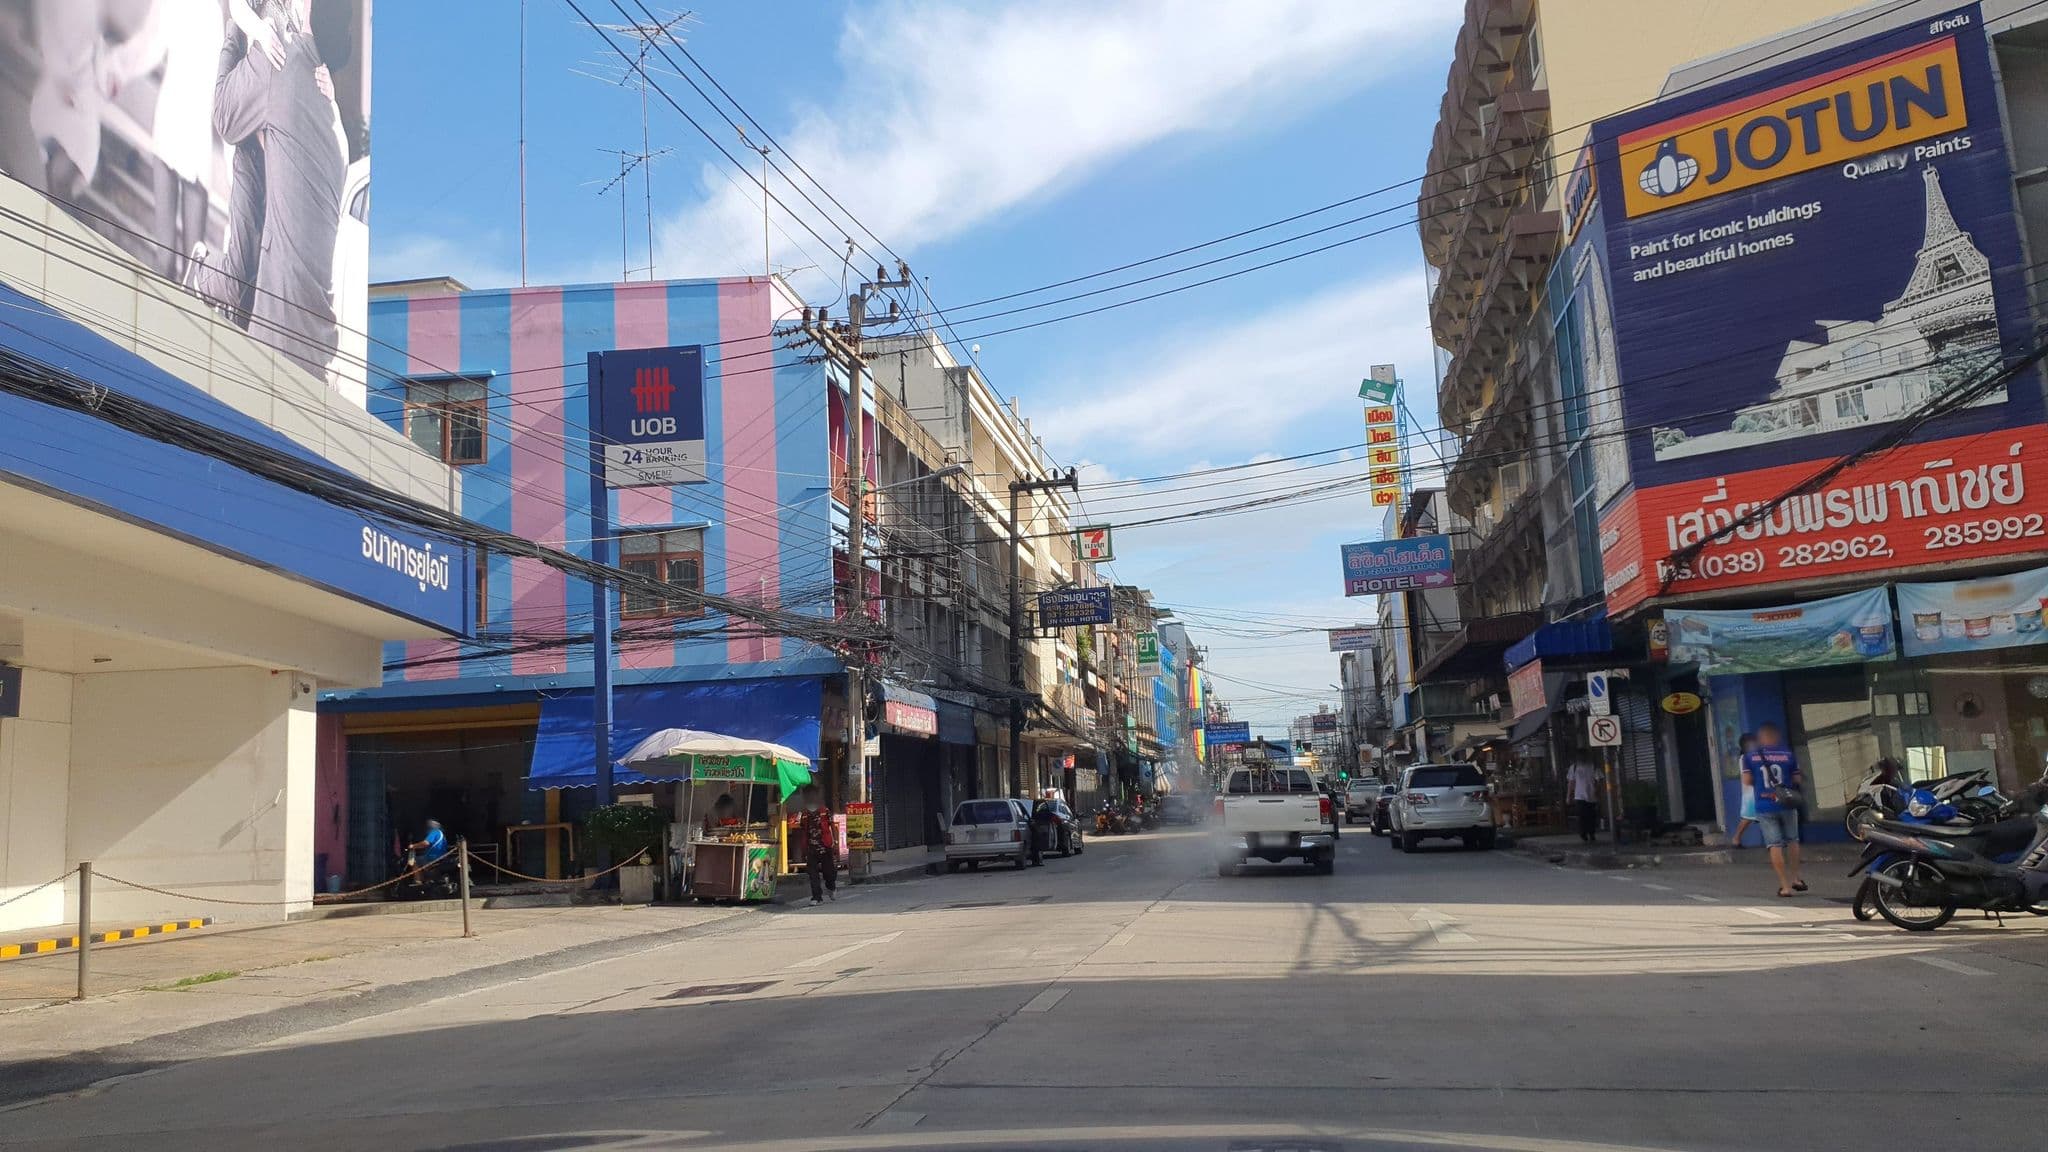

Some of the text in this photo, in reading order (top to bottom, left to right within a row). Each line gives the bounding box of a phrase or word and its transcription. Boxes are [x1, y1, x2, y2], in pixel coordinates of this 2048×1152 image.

[1705, 63, 1948, 185] JOTUN
[1842, 136, 1972, 180] Quality Paints
[1630, 201, 1822, 260] Paint for iconic buildings
[1633, 232, 1795, 283] and beautiful homes
[631, 417, 677, 436] UOB
[622, 447, 673, 465] 24 HOUR
[645, 453, 688, 464] BANKING
[638, 472, 662, 481] SME
[1666, 442, 2025, 551] เสงี่ยมพรพาณิชย์
[362, 526, 449, 593] ธนาคารยูโอบี
[1084, 530, 1105, 558] 7
[1700, 549, 1764, 579] (038)
[1778, 535, 1894, 568] 282962,
[1924, 513, 2045, 549] 285992
[1352, 575, 1422, 593] HOTEL
[1080, 615, 1104, 623] HOTEL
